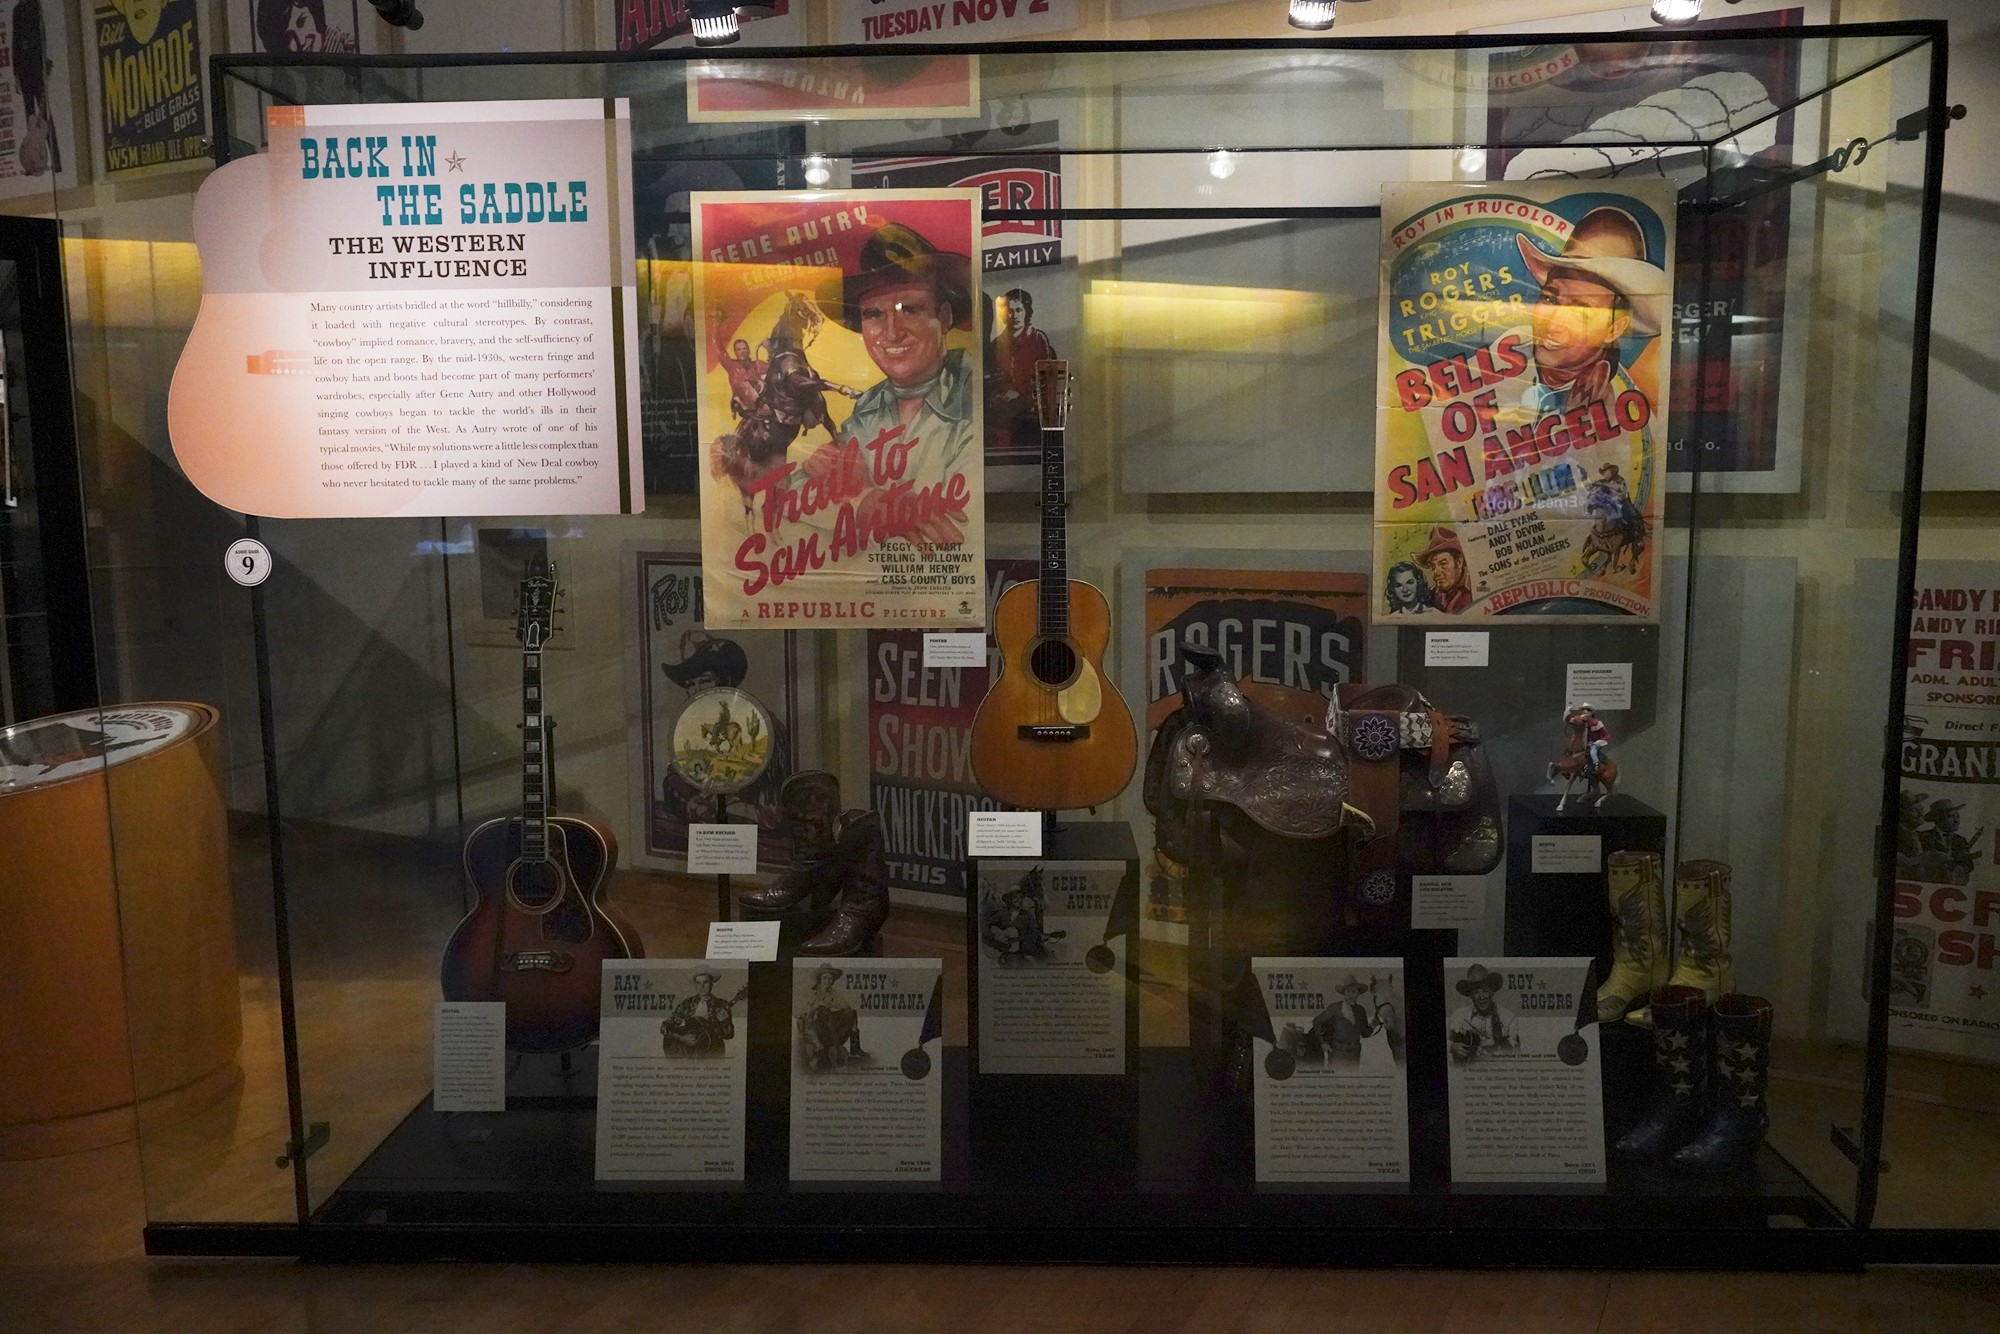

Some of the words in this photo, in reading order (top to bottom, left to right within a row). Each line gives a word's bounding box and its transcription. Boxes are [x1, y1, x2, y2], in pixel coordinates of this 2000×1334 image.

[100, 22, 125, 47] Bill
[862, 4, 946, 41] TUESDAY
[103, 20, 197, 134] MONROE
[144, 105, 167, 129] BLUE
[169, 86, 200, 115] GRASS
[173, 107, 198, 133] BOYS
[107, 146, 138, 170] WSM
[301, 136, 390, 179] BACK
[401, 135, 436, 178] IN
[377, 185, 442, 226] THE
[460, 181, 588, 224] SADDLE
[710, 234, 773, 263] GENE
[786, 205, 868, 246] AUTRY
[1392, 220, 1426, 249] ROY
[1436, 206, 1455, 224] IN
[1464, 200, 1567, 235] TRUCOLOR
[329, 236, 384, 256] THE
[392, 233, 526, 254] WESTERN
[368, 258, 528, 280] INFLUENCE
[984, 246, 1052, 269] FAMILY
[1430, 261, 1470, 285] ROY
[1400, 266, 1513, 318] ROGERS
[311, 303, 336, 314] Many
[339, 303, 374, 313] country
[376, 302, 402, 311] artists
[405, 302, 437, 311] bridled
[440, 302, 448, 310] at
[451, 302, 464, 310] the
[467, 301, 490, 310] word
[492, 300, 538, 310] “hillbilly,”
[540, 299, 592, 310] considering
[312, 321, 318, 330] it
[325, 321, 355, 329] loaded
[363, 320, 382, 329] with
[390, 320, 426, 330] negative
[434, 319, 468, 328] cultural
[476, 318, 527, 329] stereotypes.
[535, 317, 546, 327] By
[554, 316, 593, 327] contrast,
[1403, 294, 1526, 346] TRIGGER
[313, 339, 356, 350] “cowboy”
[360, 338, 394, 349] implied
[397, 340, 438, 348] romance,
[440, 337, 476, 347] bravery,
[479, 336, 496, 345] and
[499, 336, 512, 344] the
[516, 335, 580, 346] self-sufficiency
[584, 333, 594, 342] of
[314, 357, 328, 365] life
[347, 356, 360, 365] the
[365, 358, 386, 366] open
[391, 358, 418, 366] range.
[422, 355, 434, 365] By
[438, 355, 452, 363] the
[456, 354, 505, 365] mid-1930s,
[509, 352, 544, 361] western
[548, 352, 574, 362] fringe
[578, 351, 594, 360] and
[315, 374, 348, 385] cowboy
[352, 374, 370, 382] hats
[374, 373, 390, 382] and
[394, 373, 418, 381] boots
[421, 373, 438, 381] had
[442, 372, 476, 381] become
[479, 372, 497, 382] part
[501, 372, 511, 380] of
[515, 374, 540, 382] many
[543, 369, 595, 380] performers’
[1395, 334, 1528, 413] BELLS
[1441, 389, 1499, 442] OF
[1387, 445, 1475, 510] SAN
[1483, 390, 1650, 481] ANGELO
[751, 437, 866, 533] Trail
[866, 424, 919, 486] to
[1047, 450, 1060, 517] AUTRY
[734, 533, 825, 596] San
[830, 473, 970, 562] Antone
[1487, 521, 1509, 536] DALE
[1511, 511, 1539, 528] EVANS
[1489, 533, 1512, 549] ANDY
[1516, 521, 1546, 539] DEVINE
[868, 553, 916, 563] STERLING
[920, 552, 975, 563] HOLLOWAY
[880, 542, 912, 552] PEGGY
[917, 541, 962, 552] STEWART
[1488, 558, 1512, 573] SONS
[1530, 538, 1571, 559] PIONEERS
[1495, 545, 1513, 559] BOB
[1515, 534, 1546, 552] NOLAN
[242, 556, 255, 576] 9
[881, 564, 924, 574] WILLIAM
[929, 564, 961, 574] HENRY
[881, 575, 907, 585] CASS
[910, 575, 948, 585] COUNTY
[951, 575, 976, 585] BOYS
[650, 573, 690, 631] Roy
[741, 609, 749, 618] A
[758, 602, 876, 619] REPUBLIC
[884, 608, 947, 618] PICTURE
[1489, 580, 1581, 611] REPUBLIC
[1584, 587, 1650, 617] PRODUCTION
[1150, 618, 1350, 702] ROGERS
[874, 642, 961, 709] SEEN
[1945, 720, 1984, 731] Direct
[885, 861, 946, 885] THIS
[1052, 876, 1087, 891] GENE
[1066, 895, 1111, 910] AUTRY
[614, 975, 641, 991] RAY
[846, 974, 887, 990] PATSY
[1267, 974, 1294, 990] TEX
[1507, 974, 1534, 990] ROY
[614, 994, 676, 1010] WHITLEY
[860, 993, 925, 1010] MONTANA
[1275, 993, 1324, 1009] RITTER
[1521, 993, 1573, 1009] ROGERS
